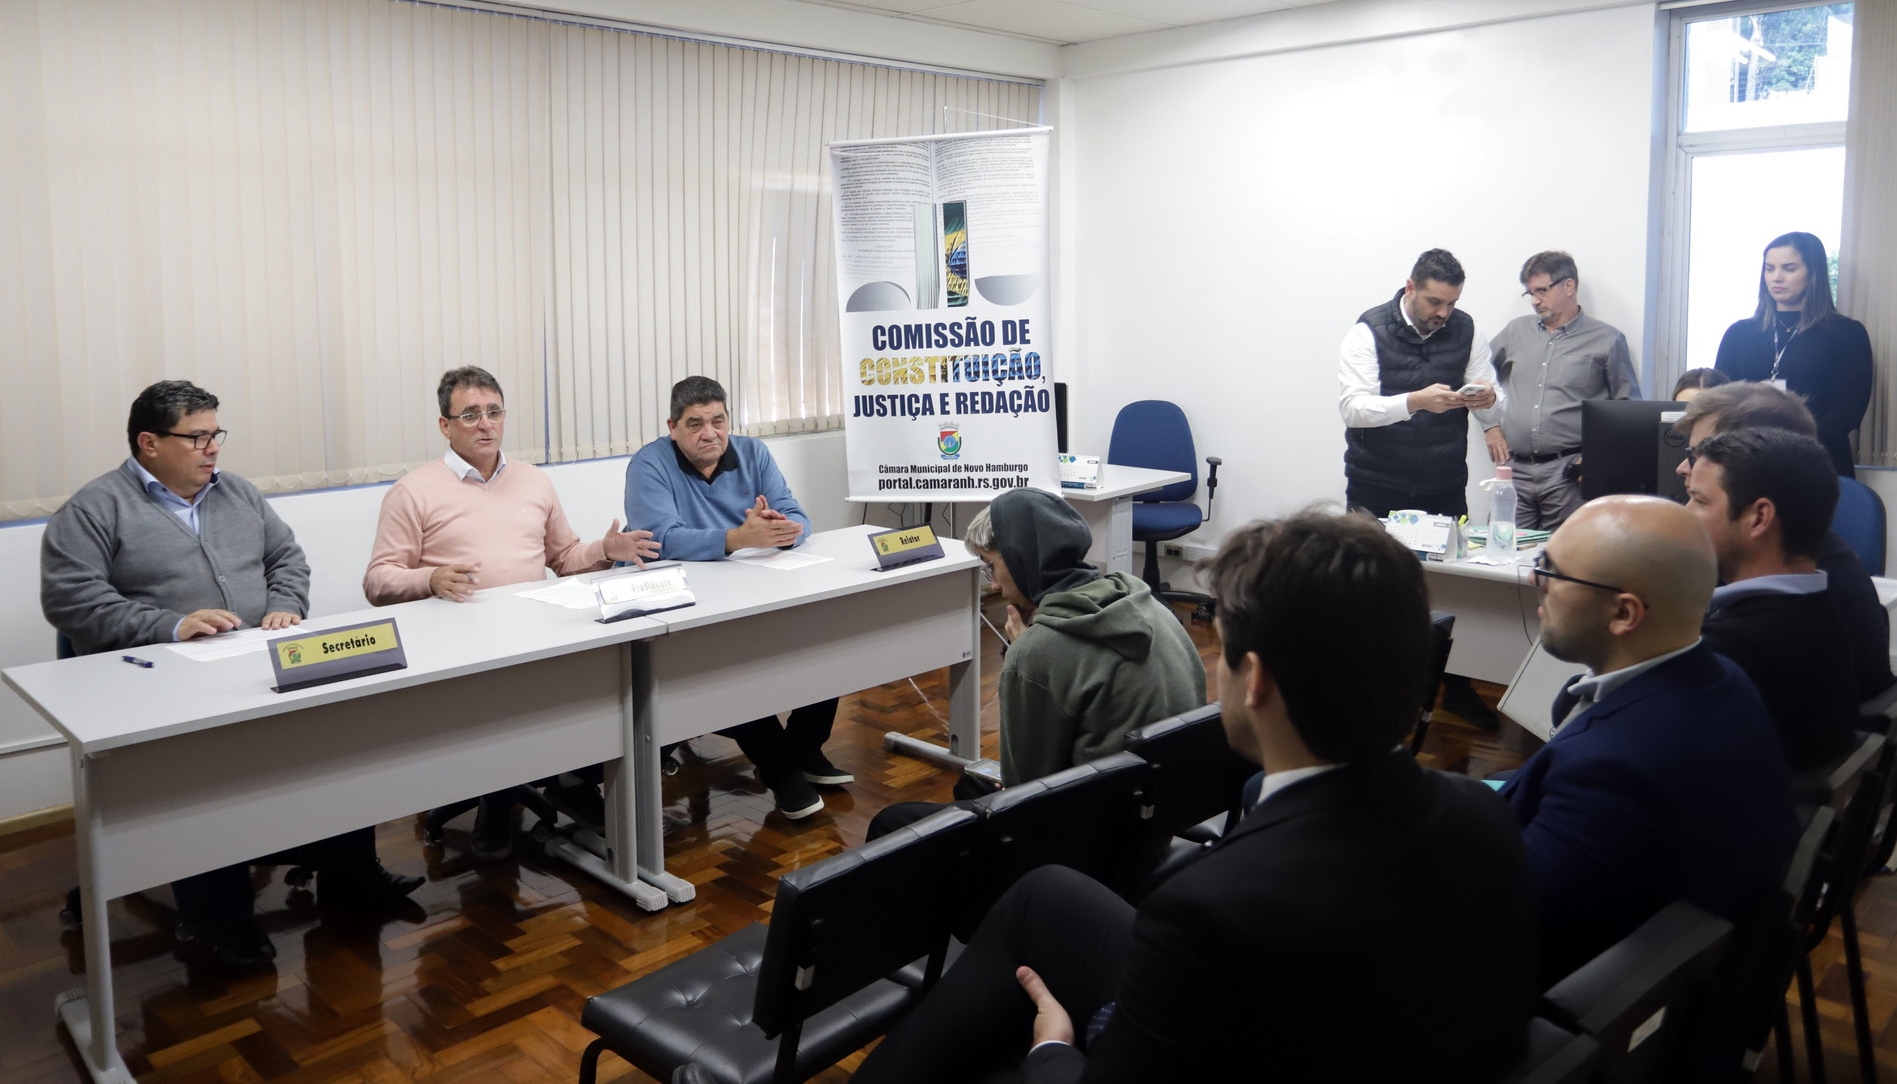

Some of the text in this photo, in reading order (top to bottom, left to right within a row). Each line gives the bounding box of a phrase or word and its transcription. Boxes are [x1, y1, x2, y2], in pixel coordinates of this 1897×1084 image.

[872, 316, 1031, 351] COMISSÃO DE
[859, 347, 1046, 387] CONSTITUIÇÃO,
[853, 385, 1050, 421] JUSTIÇA E REDAÇÃO
[878, 462, 1029, 474] Câmara Municipal de Novo Hamburgo
[878, 475, 1030, 491] portal.camaranh.rs.gov.br
[899, 535, 921, 546] Relator
[322, 633, 376, 654] Secretário
